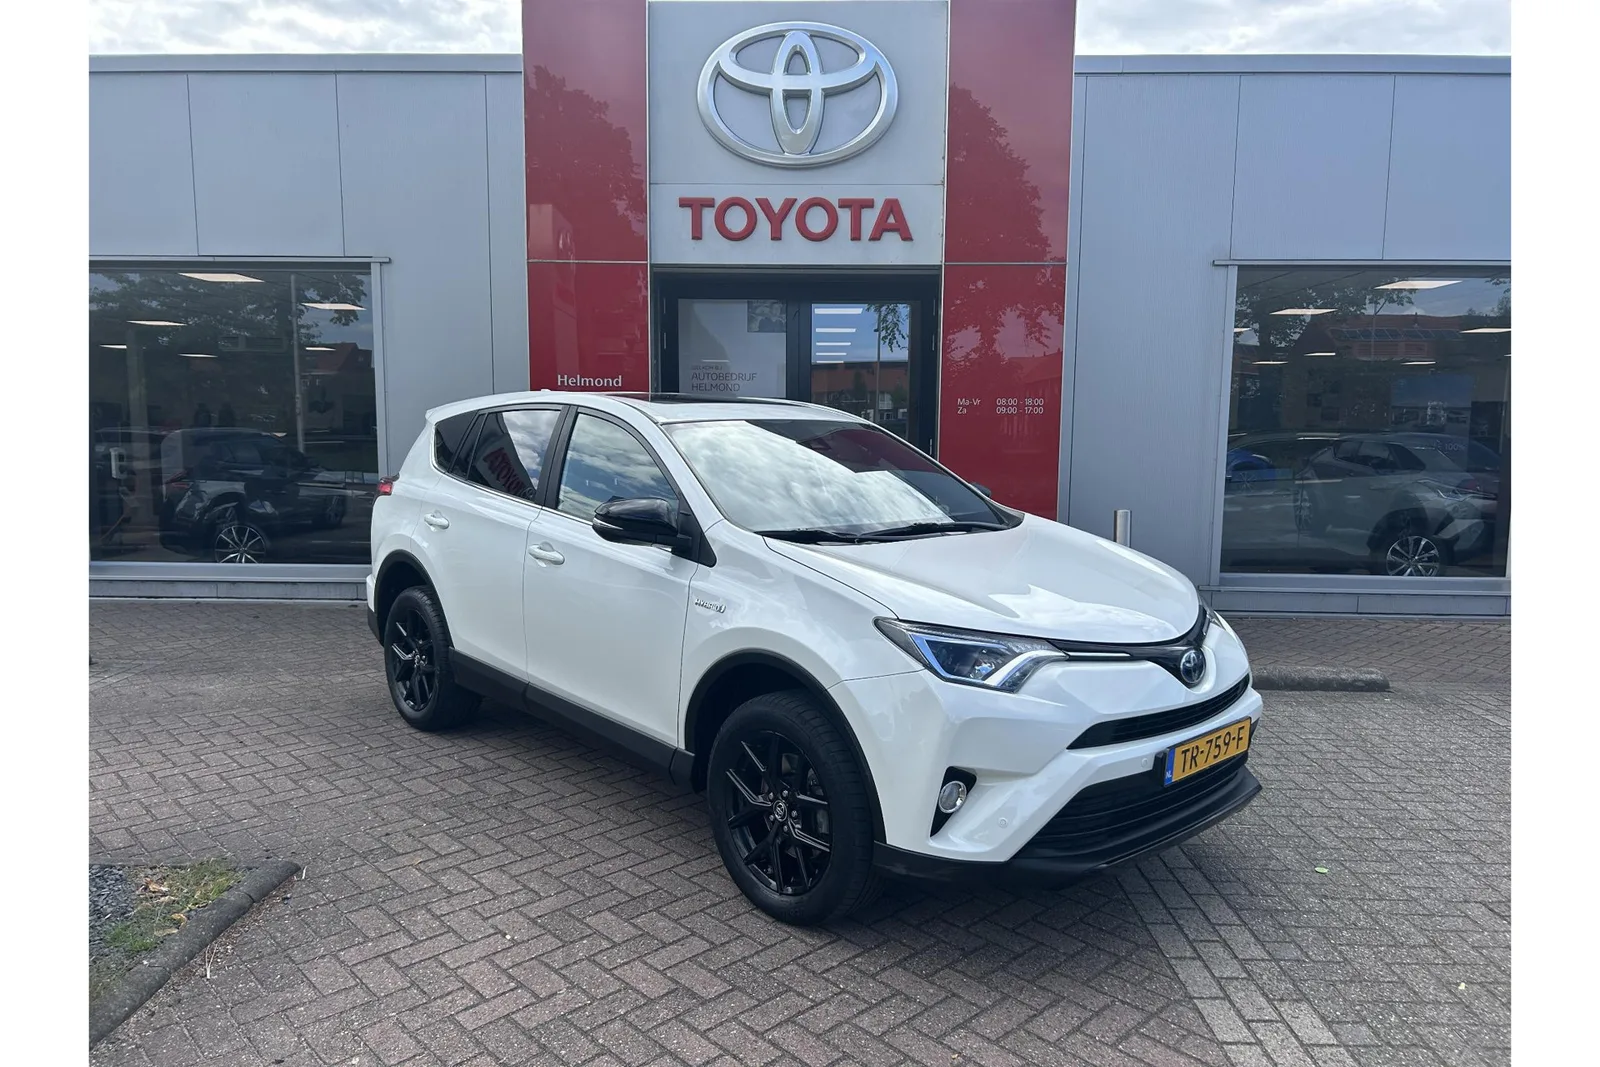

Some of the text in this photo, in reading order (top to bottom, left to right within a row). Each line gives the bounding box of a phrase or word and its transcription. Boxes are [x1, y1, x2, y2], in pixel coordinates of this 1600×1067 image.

[679, 196, 914, 242] TOYOTA
[557, 374, 622, 387] Helmond
[691, 372, 757, 381] AUTOBEDRIJF
[691, 383, 740, 391] HELMOND
[957, 398, 981, 406] Ma-Vr
[957, 406, 967, 414] Za
[1181, 725, 1245, 773] TR-759-F
[1165, 770, 1172, 779] NL
